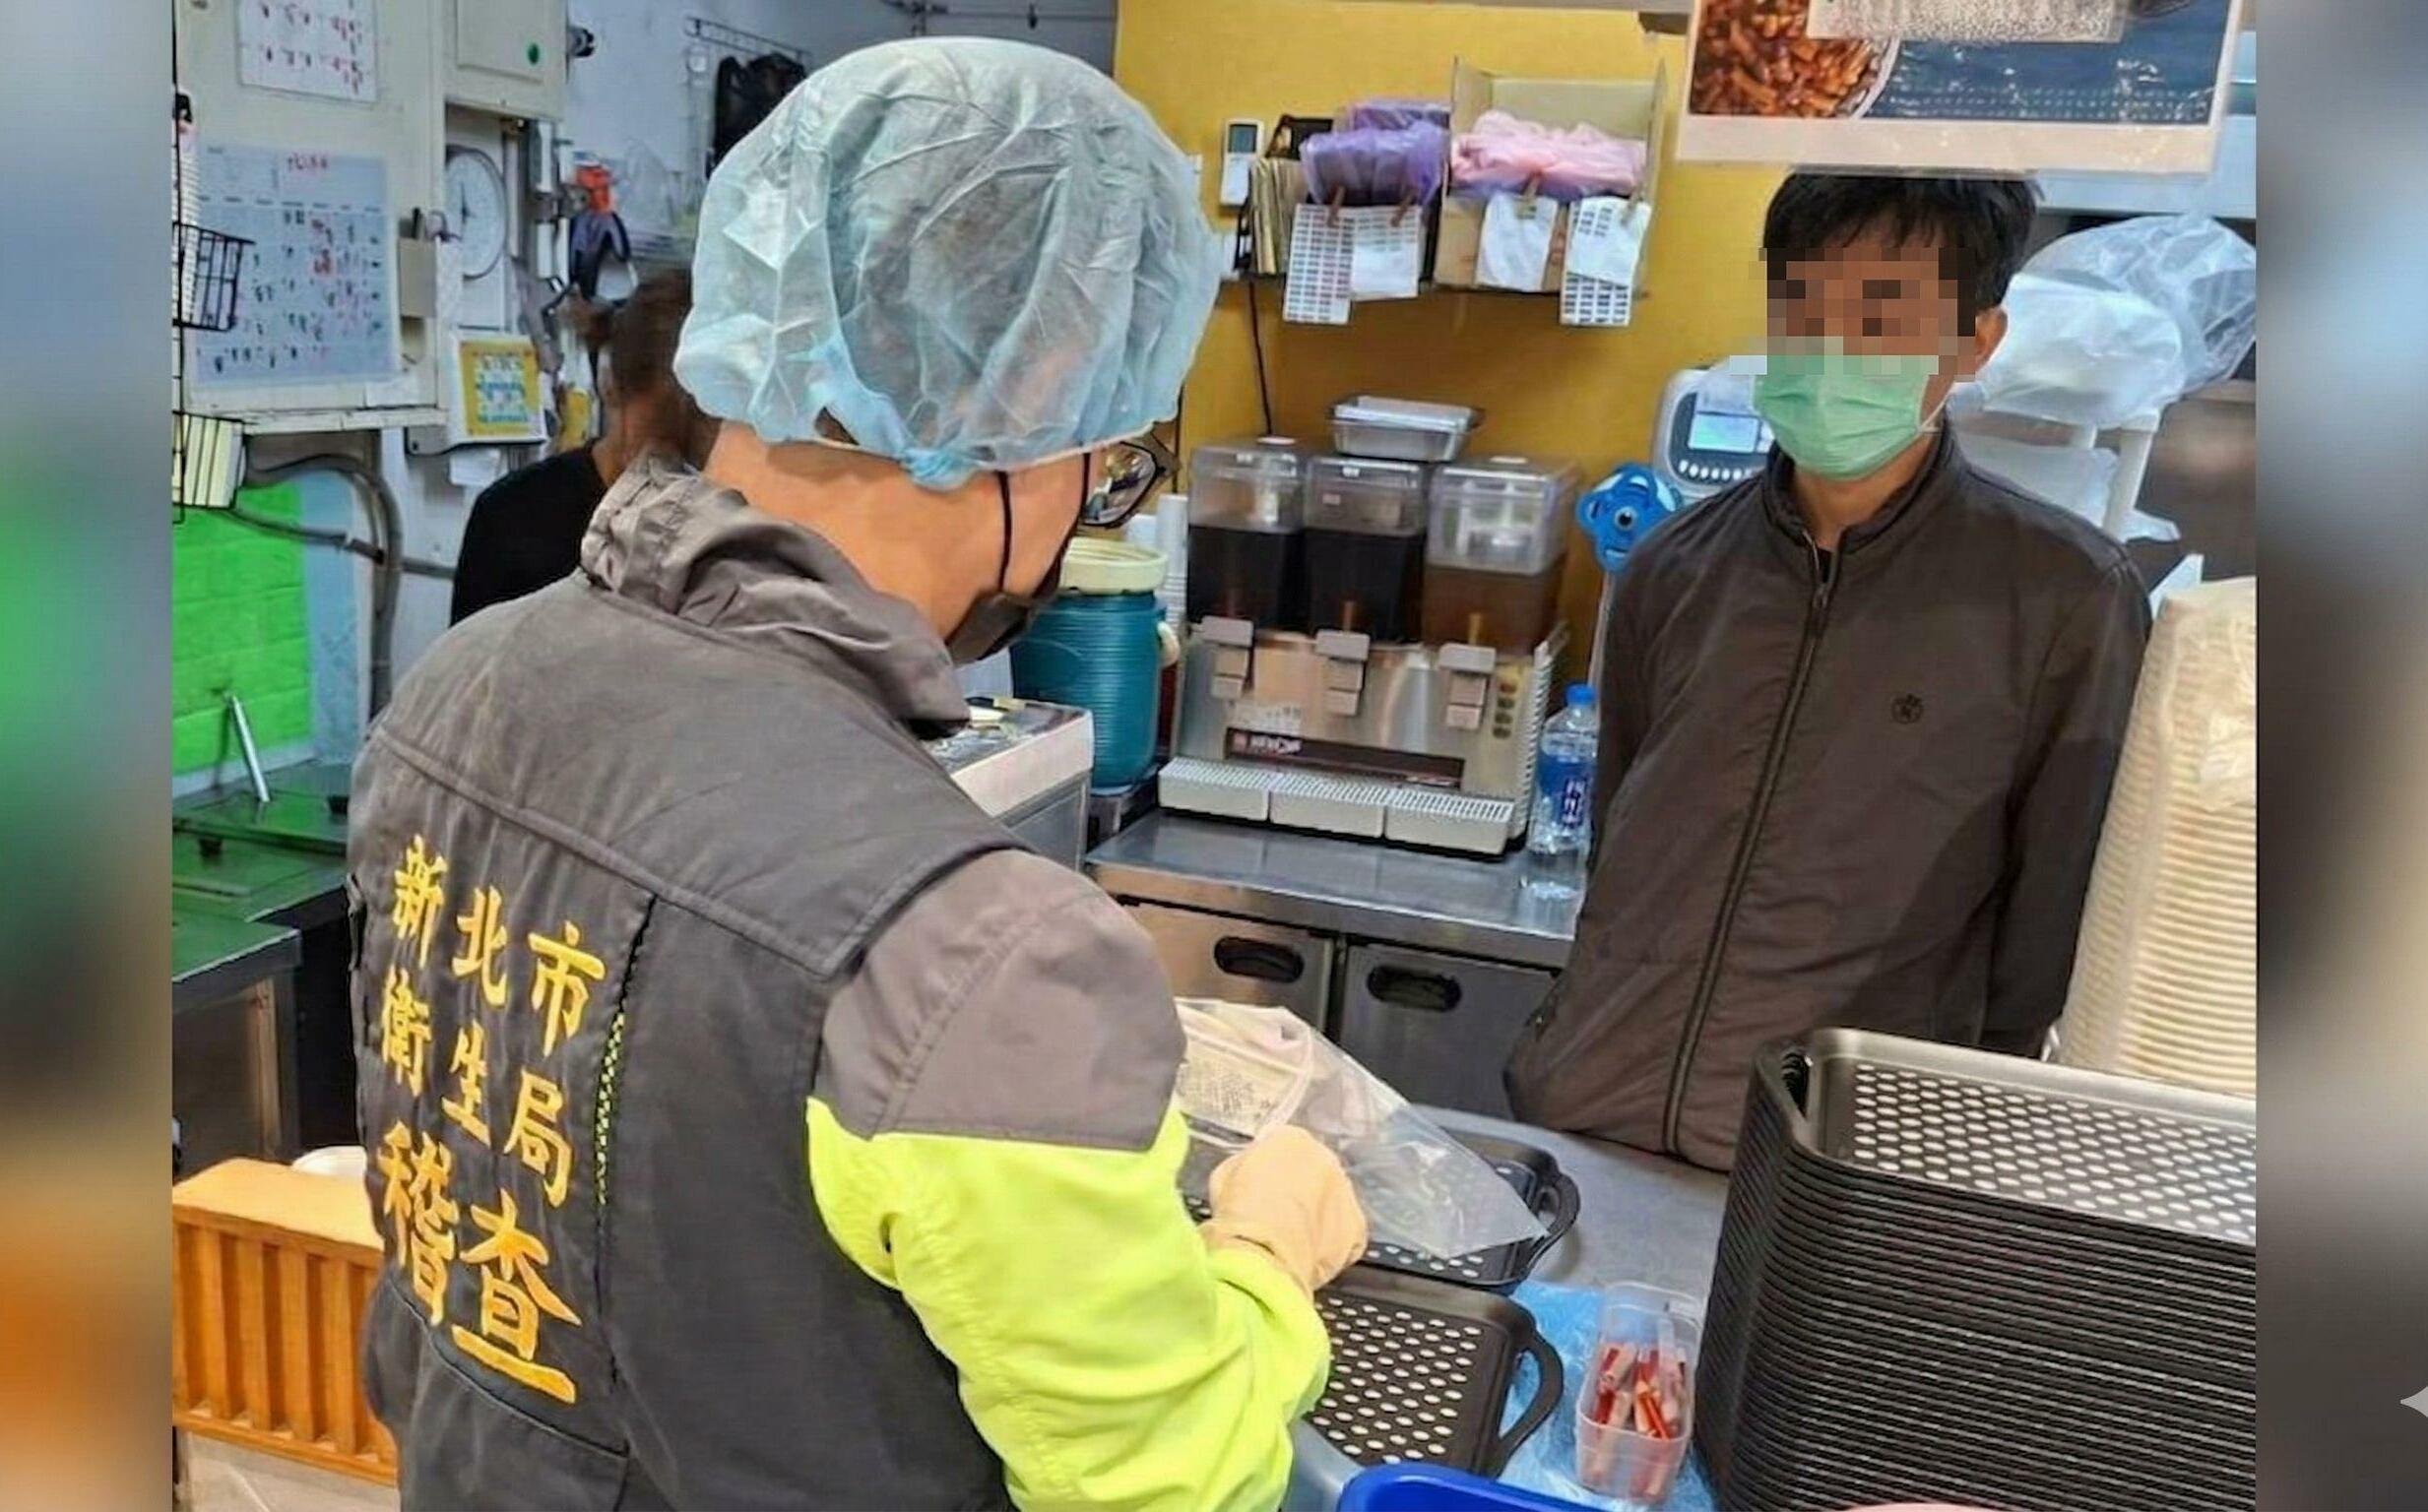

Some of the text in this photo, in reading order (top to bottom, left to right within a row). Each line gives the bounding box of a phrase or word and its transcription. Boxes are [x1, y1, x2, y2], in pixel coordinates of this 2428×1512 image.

[394, 834, 606, 1057] 新北市
[381, 965, 573, 1208] 衛生局
[377, 1120, 582, 1404] 稽查
